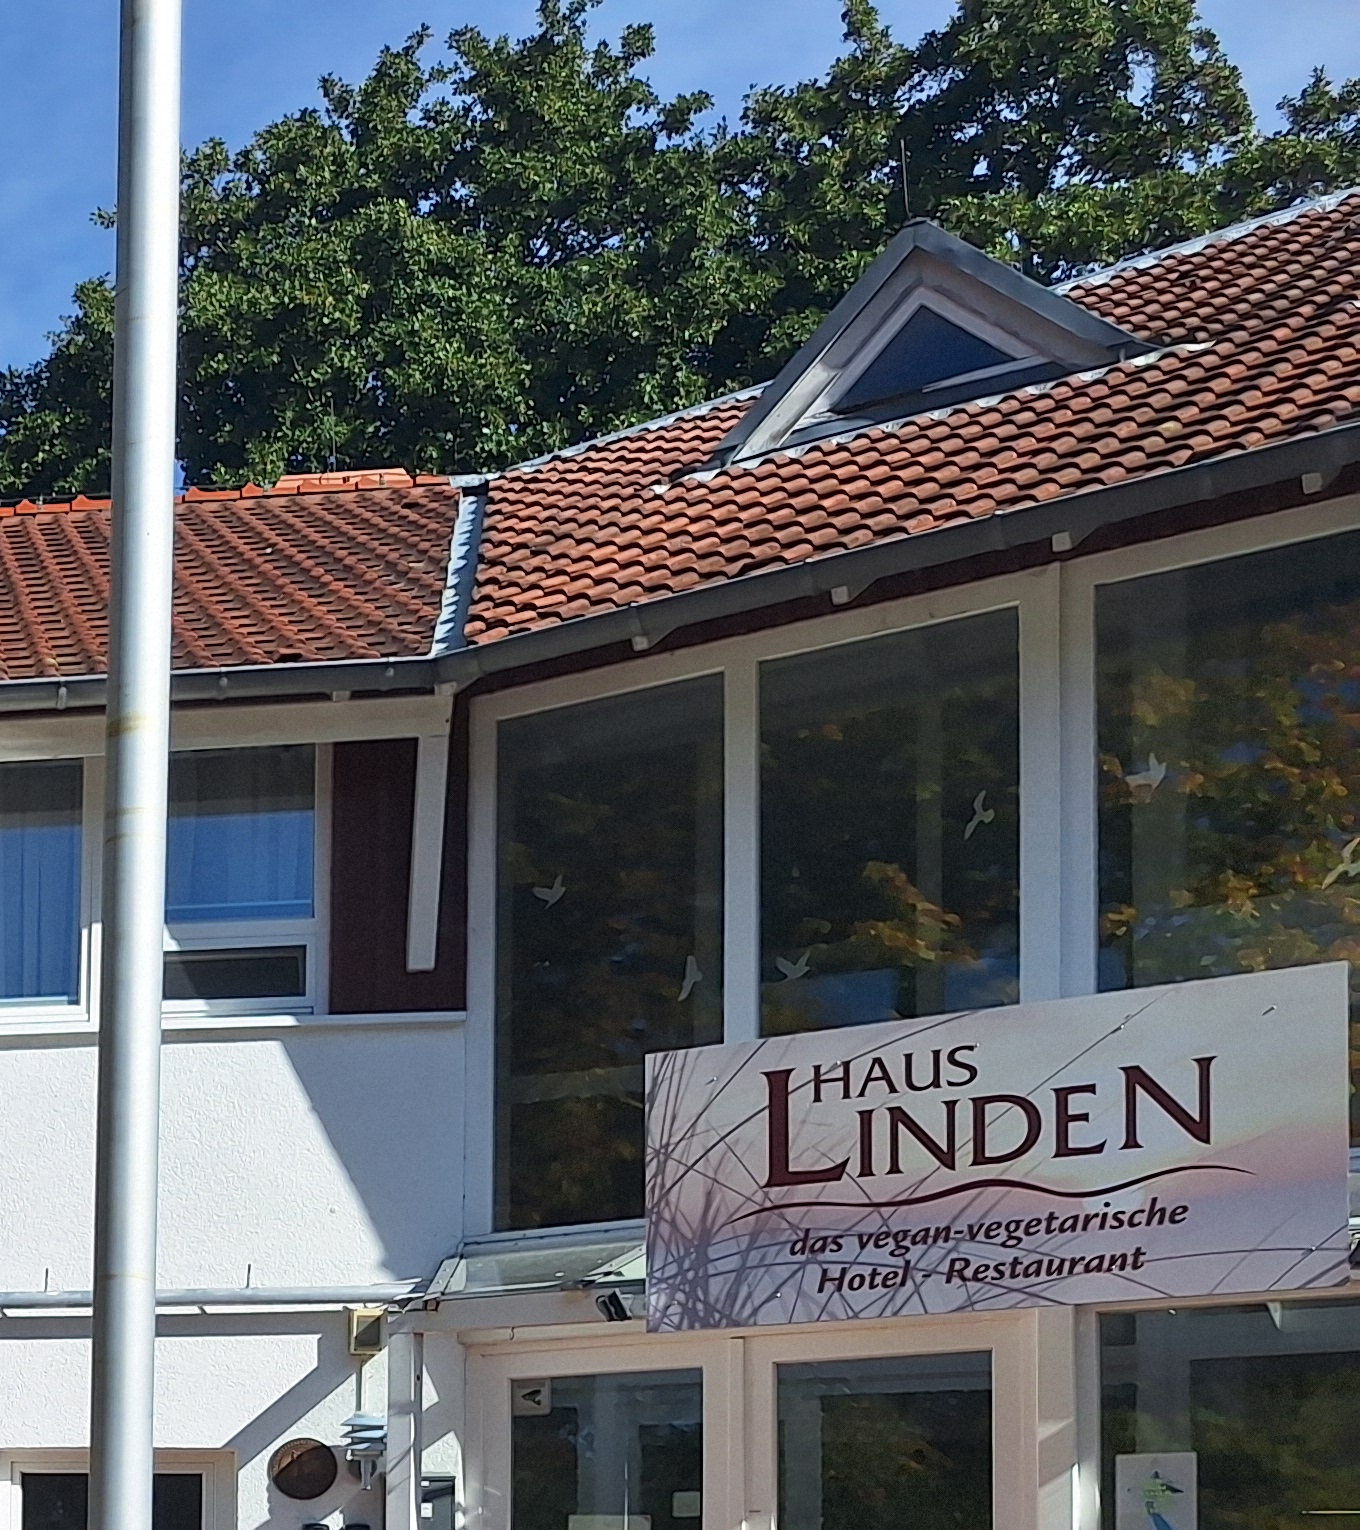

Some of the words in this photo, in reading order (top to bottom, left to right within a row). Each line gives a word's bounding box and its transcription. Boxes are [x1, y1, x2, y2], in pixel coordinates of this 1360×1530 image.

[812, 1045, 978, 1103] HAUS
[759, 1056, 1218, 1188] LINDEN
[789, 1229, 844, 1257] das
[857, 1196, 1189, 1257] vegan-vegetarische
[817, 1260, 911, 1294] Hotel
[945, 1246, 1147, 1285] Restaurant
